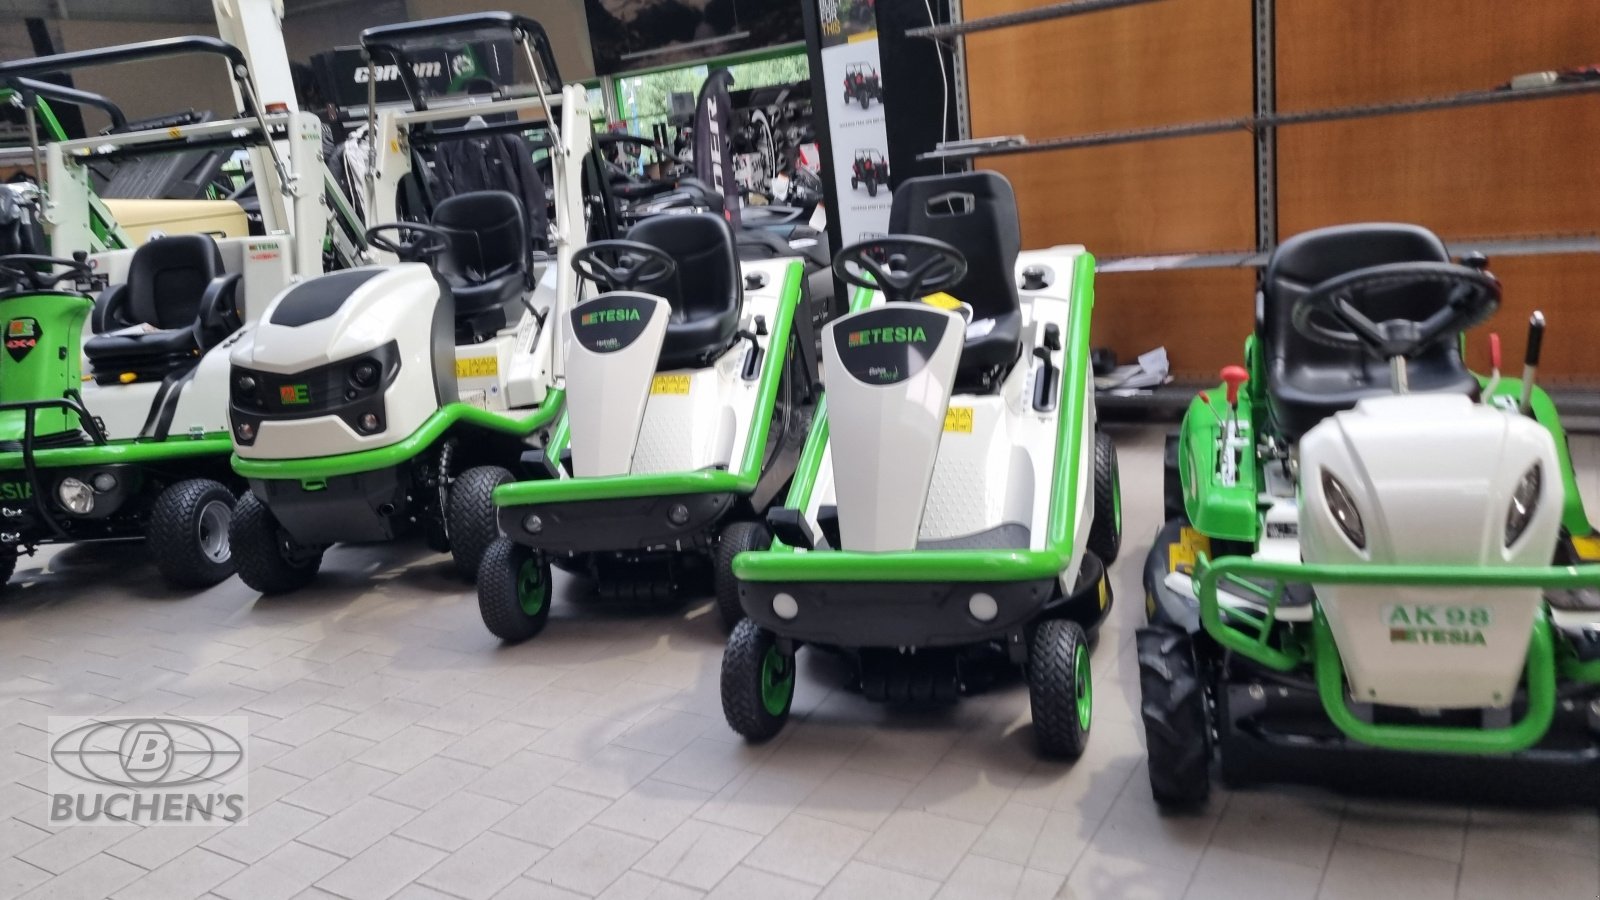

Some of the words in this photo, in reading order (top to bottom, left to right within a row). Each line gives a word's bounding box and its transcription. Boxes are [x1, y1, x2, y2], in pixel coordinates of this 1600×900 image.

[583, 308, 641, 326] ETESIA
[850, 326, 927, 347] ETESIA
[1389, 603, 1438, 626] AK
[1444, 605, 1491, 627] 98
[1390, 628, 1488, 647] ETESIA
